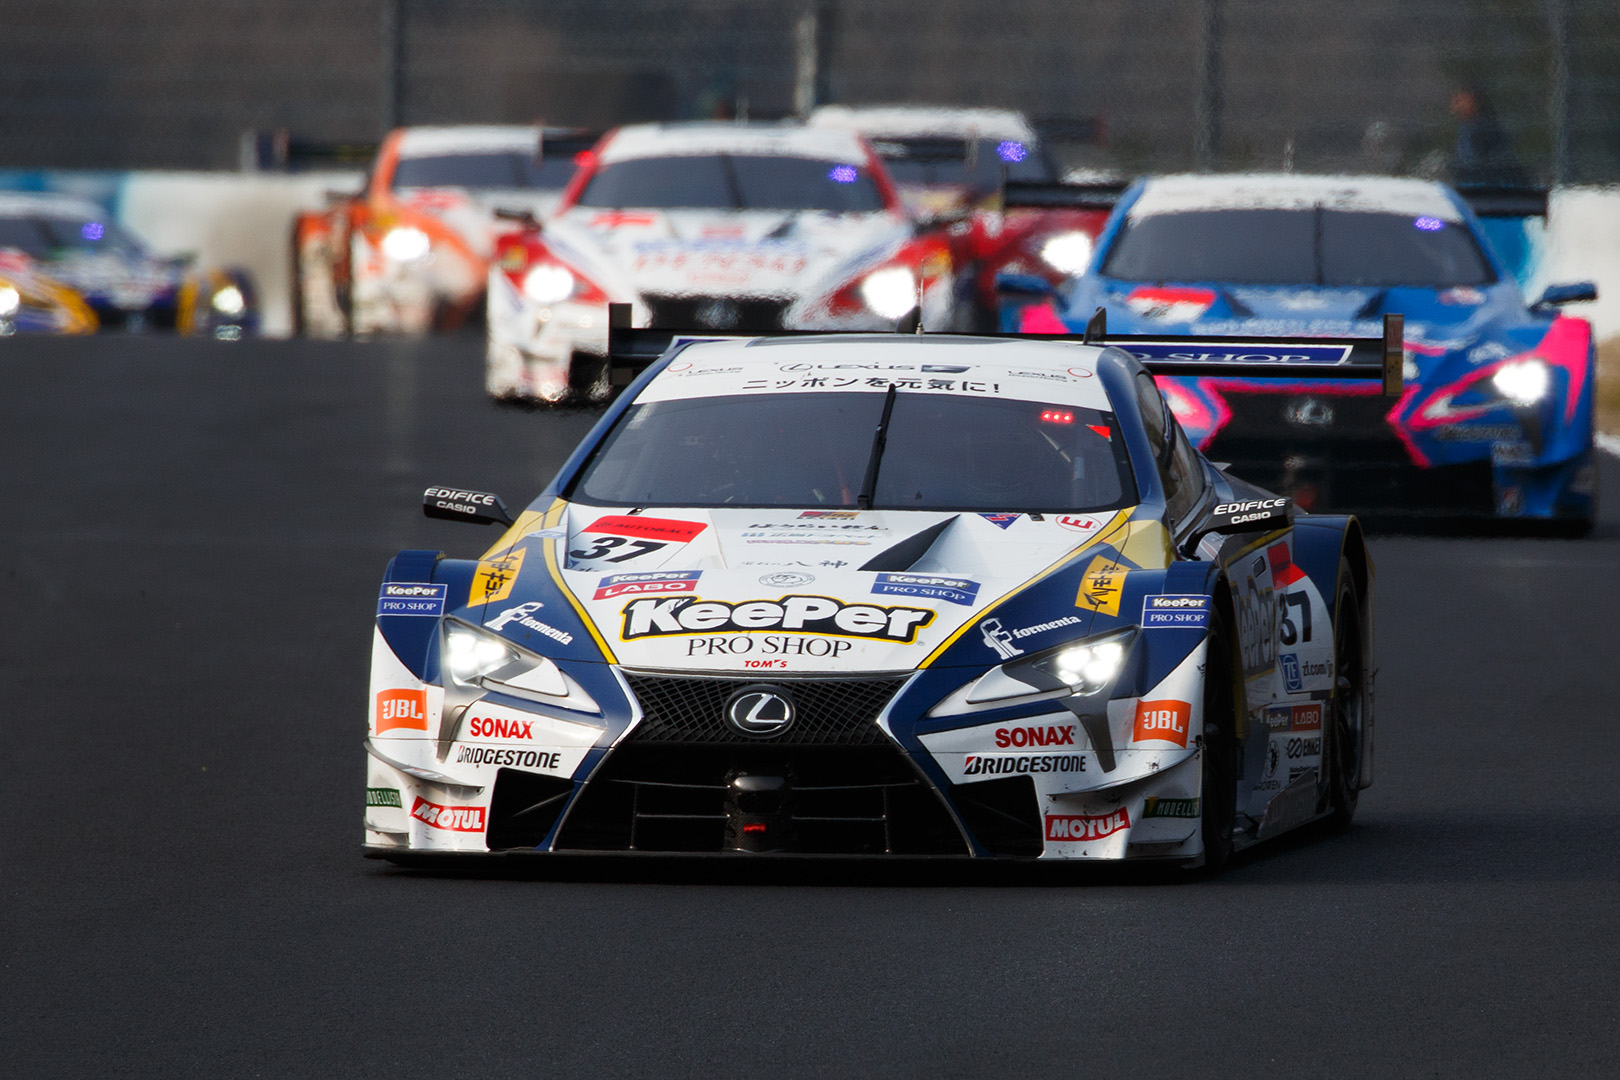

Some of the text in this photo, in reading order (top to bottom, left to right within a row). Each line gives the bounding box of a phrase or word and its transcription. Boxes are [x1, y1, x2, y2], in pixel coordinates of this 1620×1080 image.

[1166, 352, 1311, 363] SHOP
[424, 487, 496, 506] EDIFICE
[437, 500, 477, 514] CASIO
[1213, 498, 1287, 515] EDIFICE
[1231, 511, 1271, 524] CASIO
[569, 536, 668, 563] 37
[611, 571, 693, 583] KeePer
[886, 574, 971, 590] KeePer
[386, 585, 439, 596] KeePer
[604, 582, 687, 597] LABO
[882, 586, 966, 602] PRO SHOP
[383, 602, 437, 611] PRO SHOP
[1153, 597, 1206, 608] KeePer
[625, 596, 933, 641] KeePer
[1150, 613, 1205, 622] PRO SHOP
[1279, 590, 1312, 646] 37
[686, 635, 852, 658] PRO SHOP
[744, 659, 788, 669] TOM'S
[382, 698, 424, 720] JBL
[1143, 710, 1184, 734] JBL
[1295, 711, 1319, 725] LABO
[470, 716, 533, 740] SONAX
[995, 725, 1075, 748] SONAX
[456, 745, 562, 769] BRIDGESTONE
[963, 755, 1087, 775] BRIDGESTONE
[413, 801, 484, 830] MOTUL
[1050, 812, 1127, 839] MOTUL
